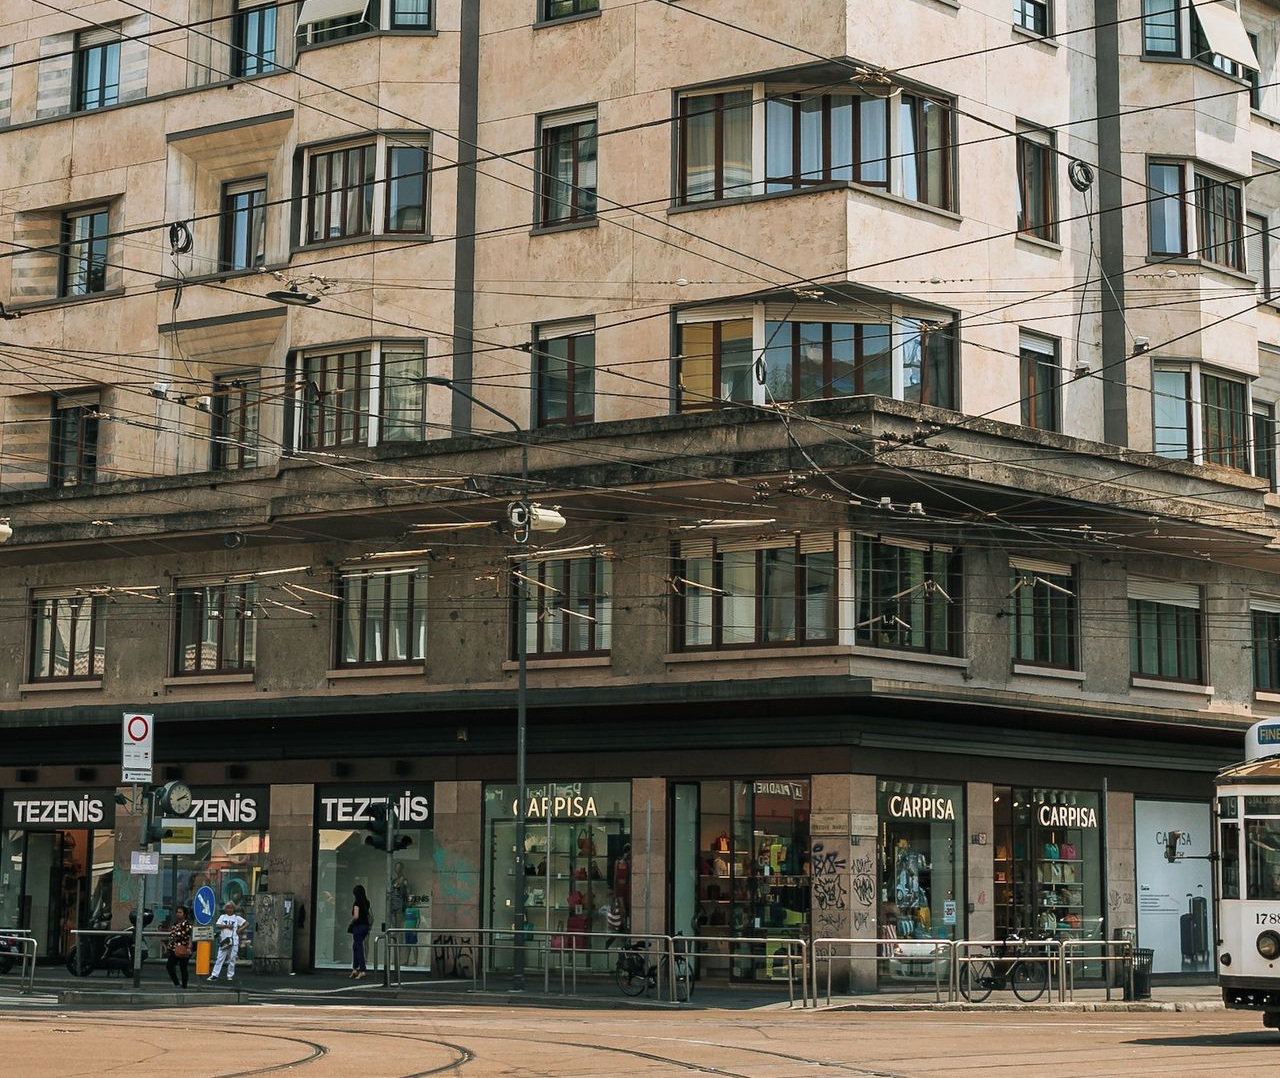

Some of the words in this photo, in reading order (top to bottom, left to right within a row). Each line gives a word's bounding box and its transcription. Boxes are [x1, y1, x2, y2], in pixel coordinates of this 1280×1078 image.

[188, 793, 256, 822] ZENIS
[890, 795, 955, 820] CARPISA
[1039, 805, 1097, 828] CARPISA
[1156, 831, 1192, 845] CAISA
